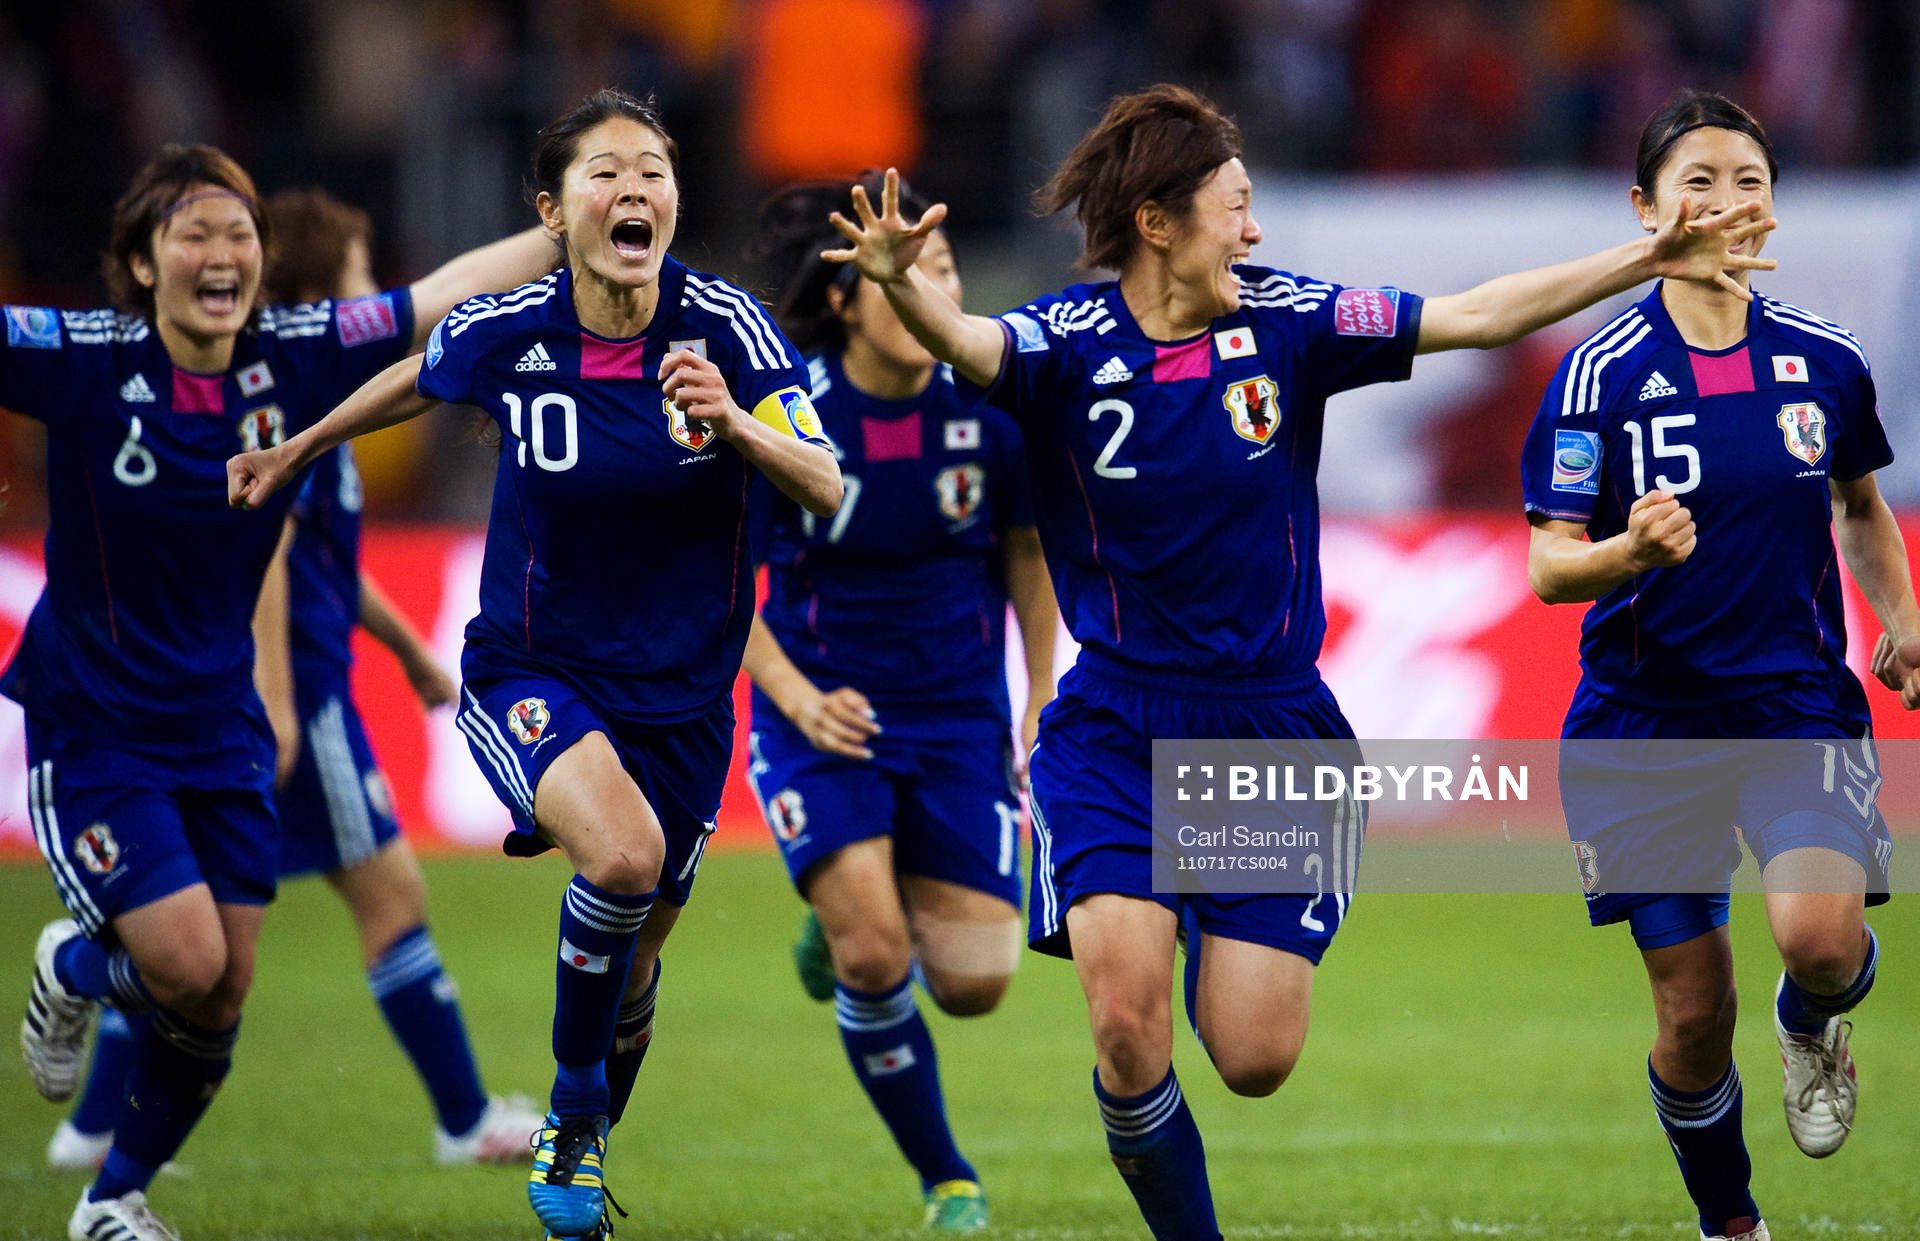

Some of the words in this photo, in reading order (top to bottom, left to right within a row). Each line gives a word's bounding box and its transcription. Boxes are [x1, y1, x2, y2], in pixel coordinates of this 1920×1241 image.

[1340, 299, 1356, 331] LIVE
[1353, 292, 1372, 332] YOUR
[1366, 290, 1388, 334] GOALS
[515, 360, 557, 372] adidas
[1093, 371, 1134, 384] adidas
[1639, 386, 1678, 401] adidas
[113, 415, 158, 487] 6
[502, 392, 578, 472] 10
[1088, 399, 1137, 479] 2
[678, 452, 717, 466] JAPAN
[1623, 413, 1701, 497] 15
[1795, 470, 1826, 478] JAPAN
[1300, 853, 1325, 932] 2
